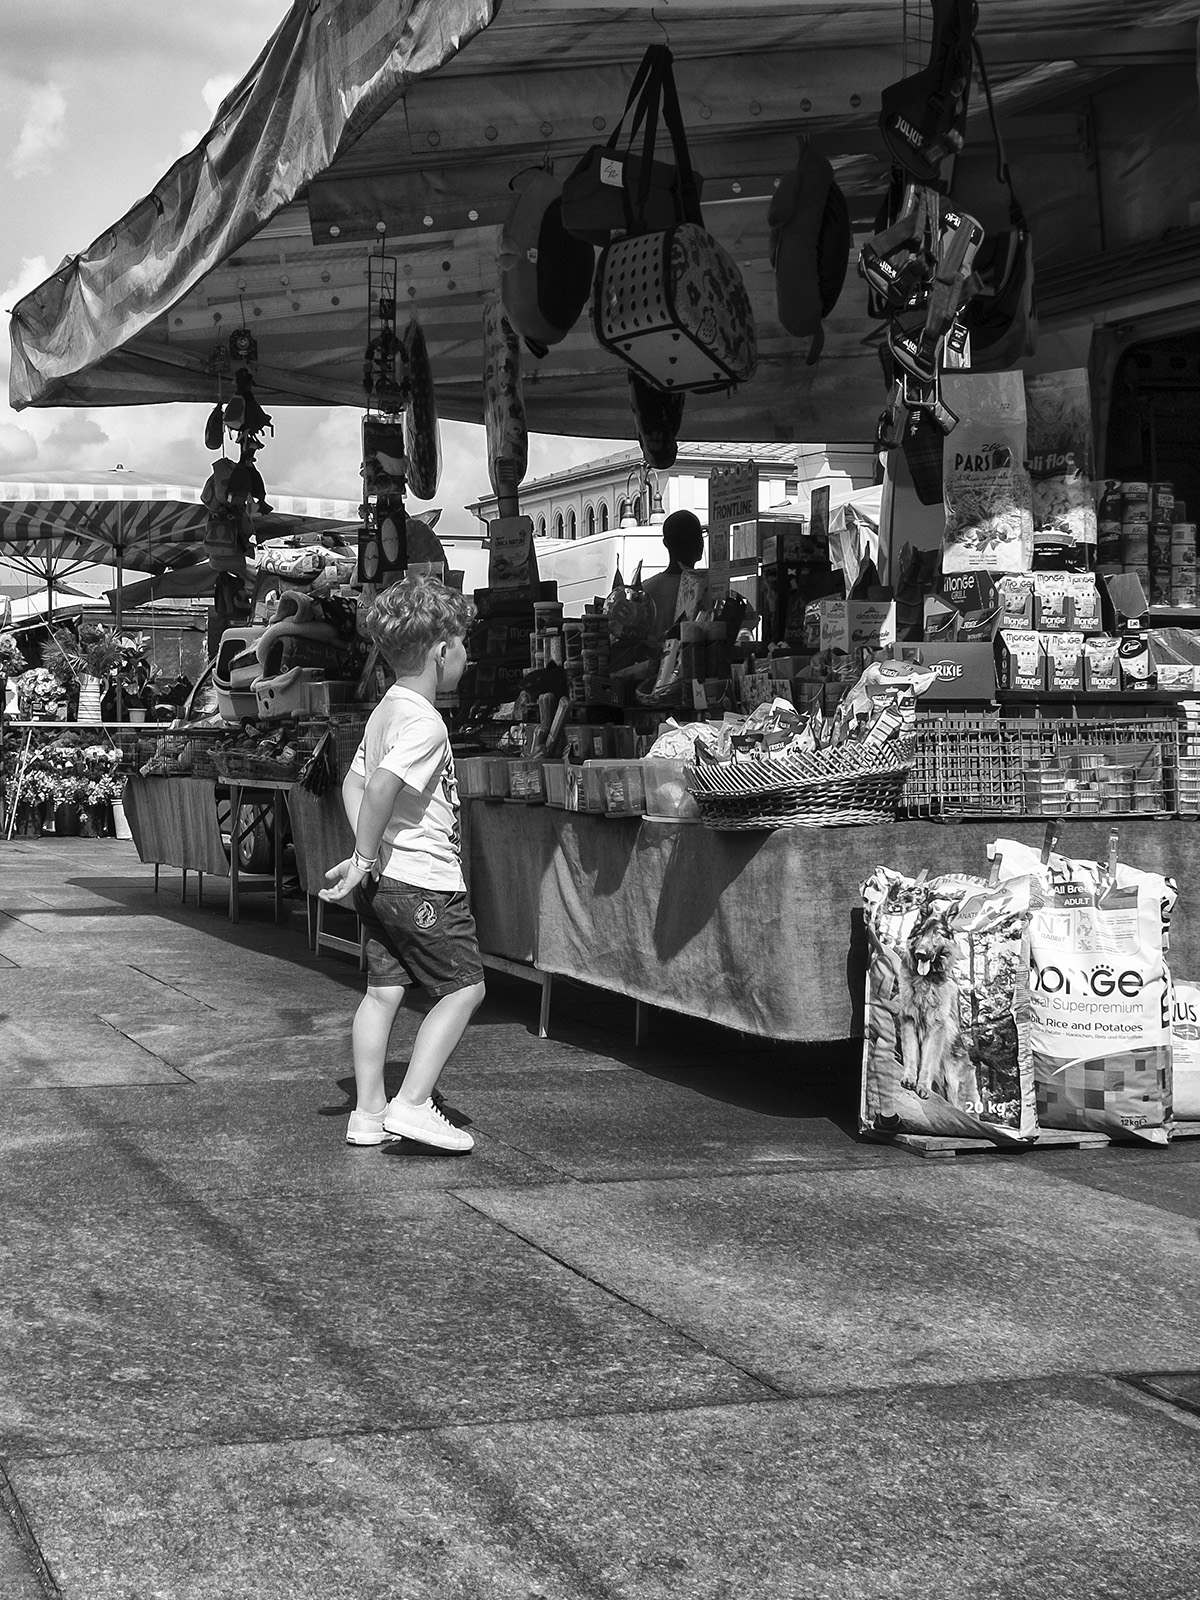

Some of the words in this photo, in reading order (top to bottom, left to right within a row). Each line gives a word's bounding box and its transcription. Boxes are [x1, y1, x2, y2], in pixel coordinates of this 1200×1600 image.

[713, 500, 752, 520] FRONTLINE
[929, 664, 963, 677] TRIXIE
[1054, 885, 1065, 894] All
[1063, 898, 1090, 906] ADULT
[1040, 933, 1066, 942] RABBIT
[1052, 997, 1144, 1015] Superpremium
[1046, 1017, 1068, 1029] Rice
[1071, 1022, 1092, 1031] and
[1094, 1021, 1144, 1032] Potatoes
[965, 1101, 984, 1114] 20
[987, 1101, 1006, 1117] kg
